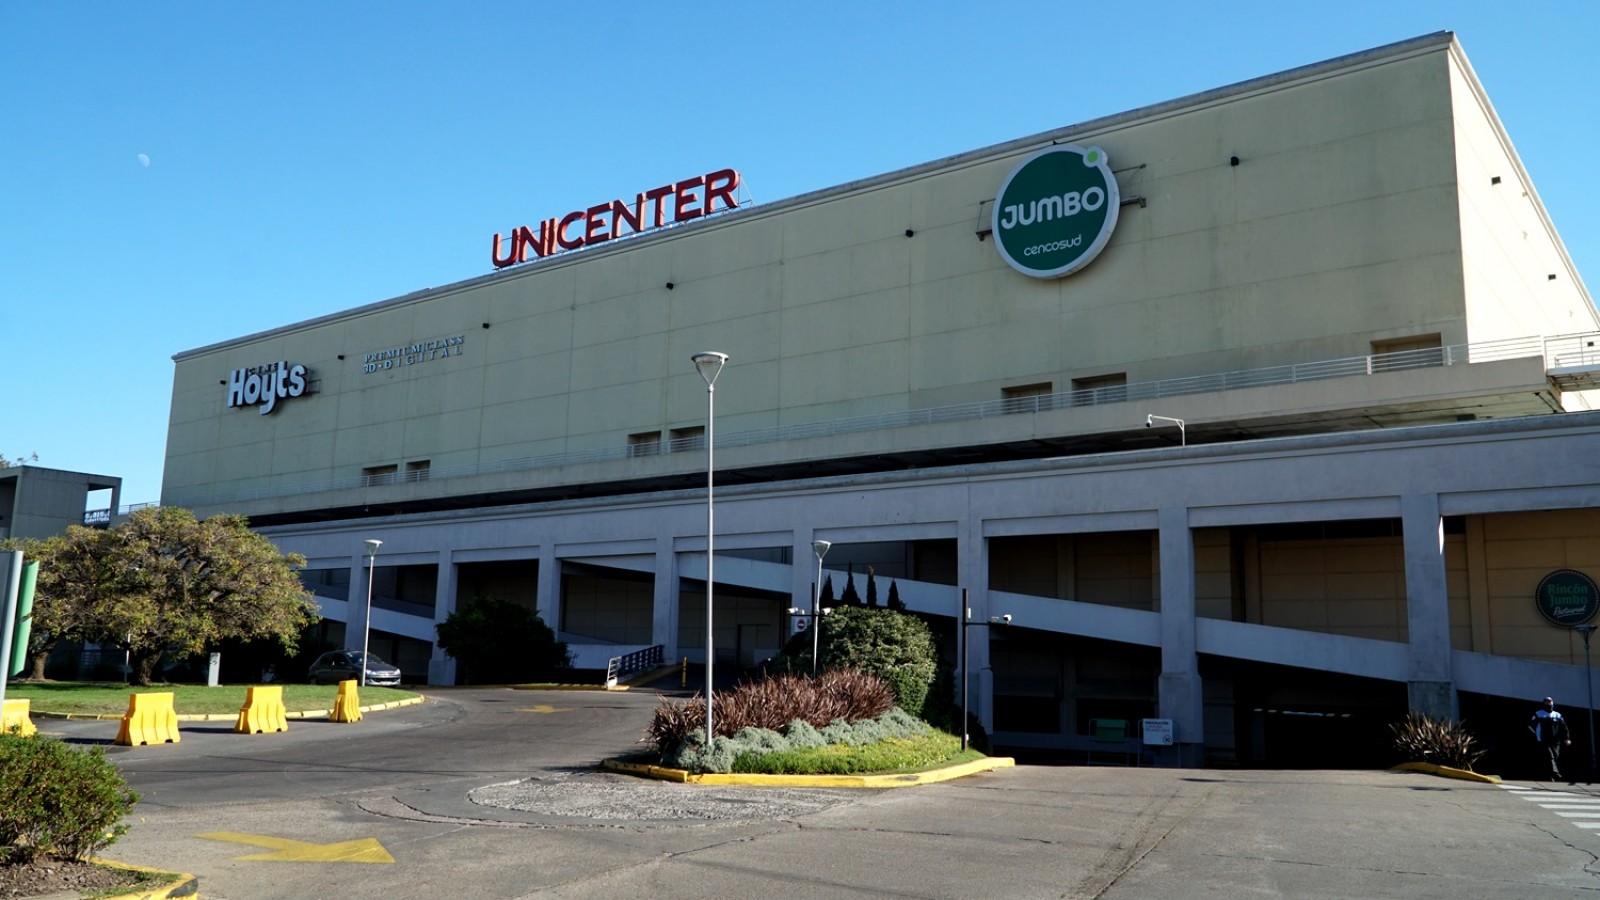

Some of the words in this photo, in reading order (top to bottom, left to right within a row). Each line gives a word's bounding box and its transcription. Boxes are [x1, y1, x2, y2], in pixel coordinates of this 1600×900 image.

[492, 168, 740, 268] UNICENTER
[1001, 186, 1105, 230] JUMBO
[1023, 234, 1083, 257] cencosud
[227, 360, 307, 415] Hoyts
[1550, 594, 1588, 607] Jumbo
